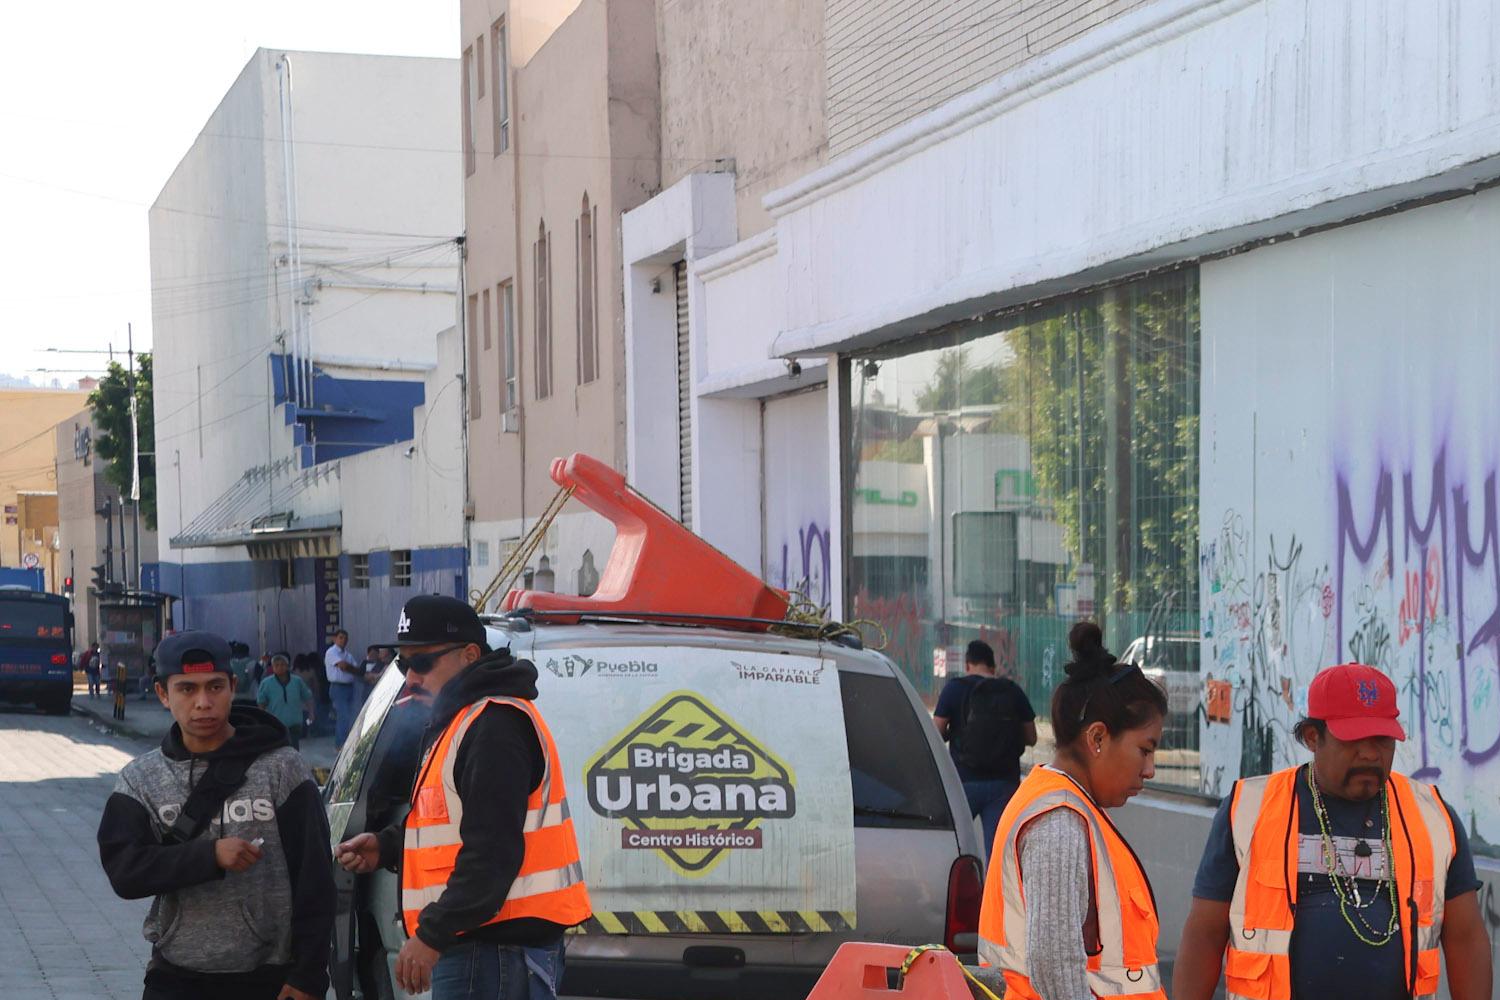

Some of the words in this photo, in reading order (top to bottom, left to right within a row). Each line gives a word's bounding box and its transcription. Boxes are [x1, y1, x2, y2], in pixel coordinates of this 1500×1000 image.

[597, 660, 658, 673] Puebla
[739, 671, 821, 685] IMPARABLE
[634, 746, 749, 774] Brigada
[596, 774, 788, 812] Urbana
[628, 833, 683, 847] Centro
[686, 832, 754, 847] Histórico
